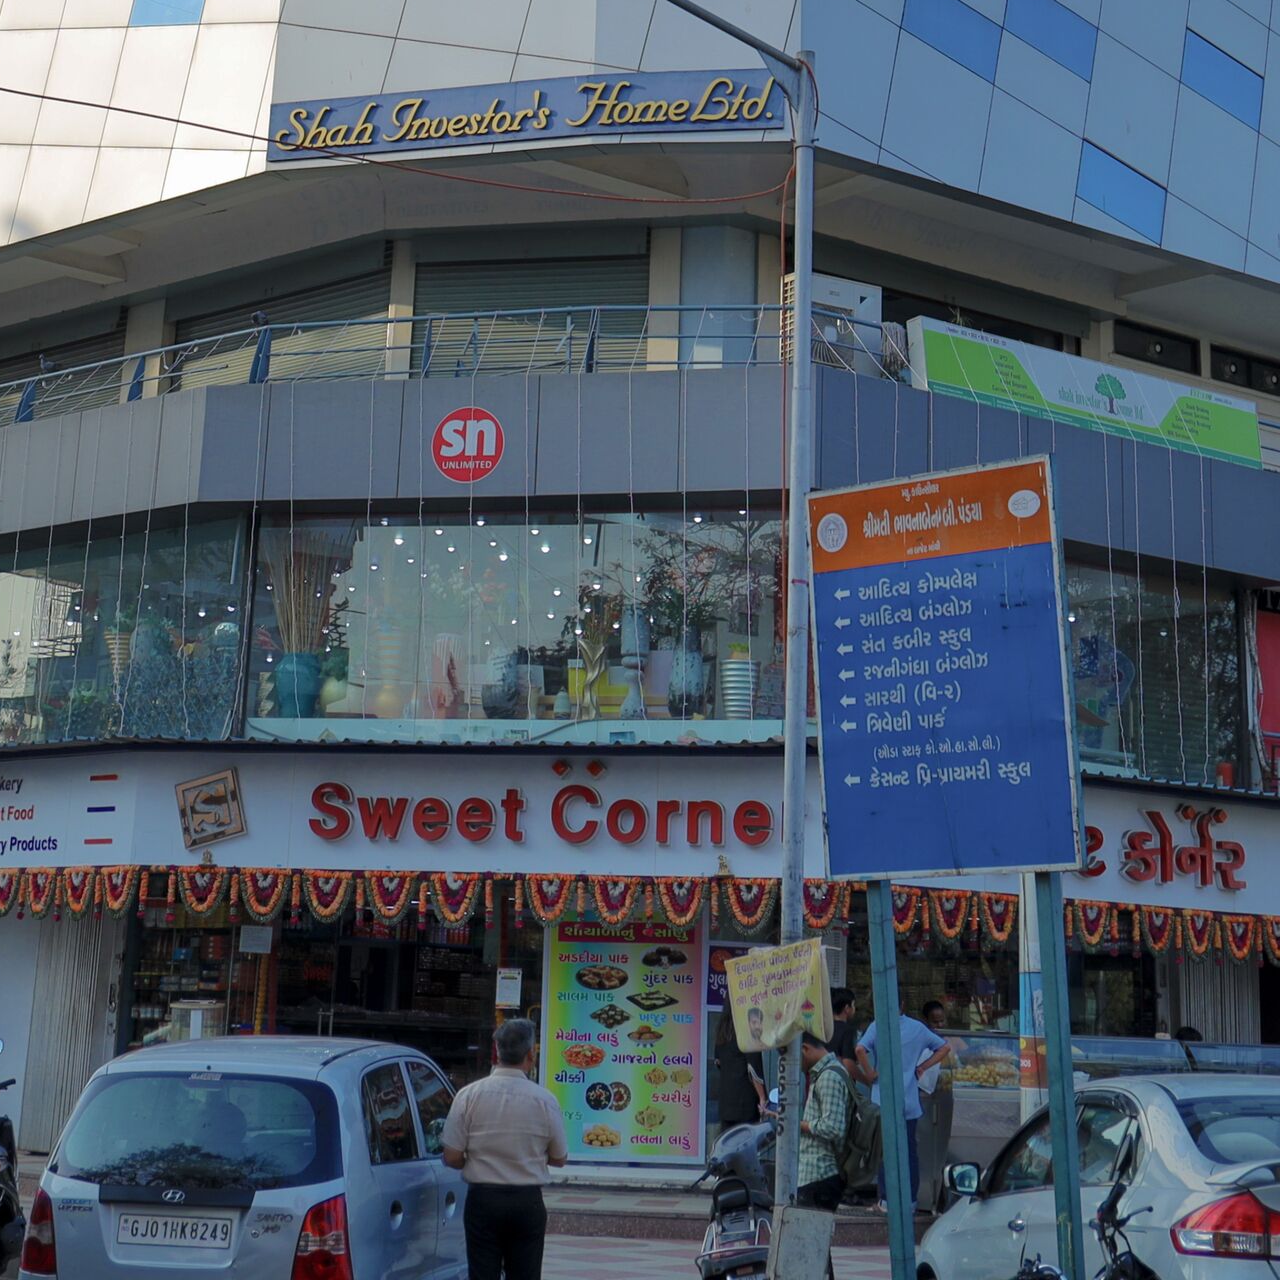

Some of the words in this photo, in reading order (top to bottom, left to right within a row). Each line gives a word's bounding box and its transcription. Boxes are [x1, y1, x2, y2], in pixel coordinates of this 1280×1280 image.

[275, 103, 377, 151] Shah
[383, 90, 551, 142] Investor's
[565, 80, 686, 127] Home
[686, 76, 774, 122] Ltd.
[440, 419, 496, 457] sn
[442, 460, 491, 470] UNLIMITED
[863, 508, 890, 539] શ્રીમતી
[858, 578, 911, 601] આદિત્ય
[917, 570, 977, 594] કોમ્પલેક્ષ
[859, 604, 913, 628] આદિત્ય
[919, 596, 972, 621] બંગ્લોઝ
[862, 634, 886, 654] સંત
[892, 628, 932, 651] કબીર
[864, 659, 929, 681] રજનીગંધા
[936, 649, 989, 673] બંગ્લોઝ
[864, 683, 906, 707] સારથી
[867, 710, 911, 734] ત્રિવેણી
[919, 707, 948, 729] પાર્ક
[7, 805, 34, 821] Food
[308, 781, 526, 844] Sweet
[550, 783, 784, 847] Corne
[9, 835, 58, 852] Products
[559, 951, 602, 963] અડદીયા
[608, 954, 629, 963] પાક
[643, 971, 667, 987] ગુંદર
[674, 975, 693, 984] પાક
[557, 992, 588, 1001] સાલમ
[595, 993, 614, 1001] પાક
[673, 1015, 693, 1023] પાક
[612, 1052, 656, 1064] ગાજરનો
[663, 1052, 693, 1065] હલવો
[562, 1111, 582, 1120] જક
[631, 1135, 662, 1144] તલના
[130, 1221, 229, 1241] GJ01HK8249
